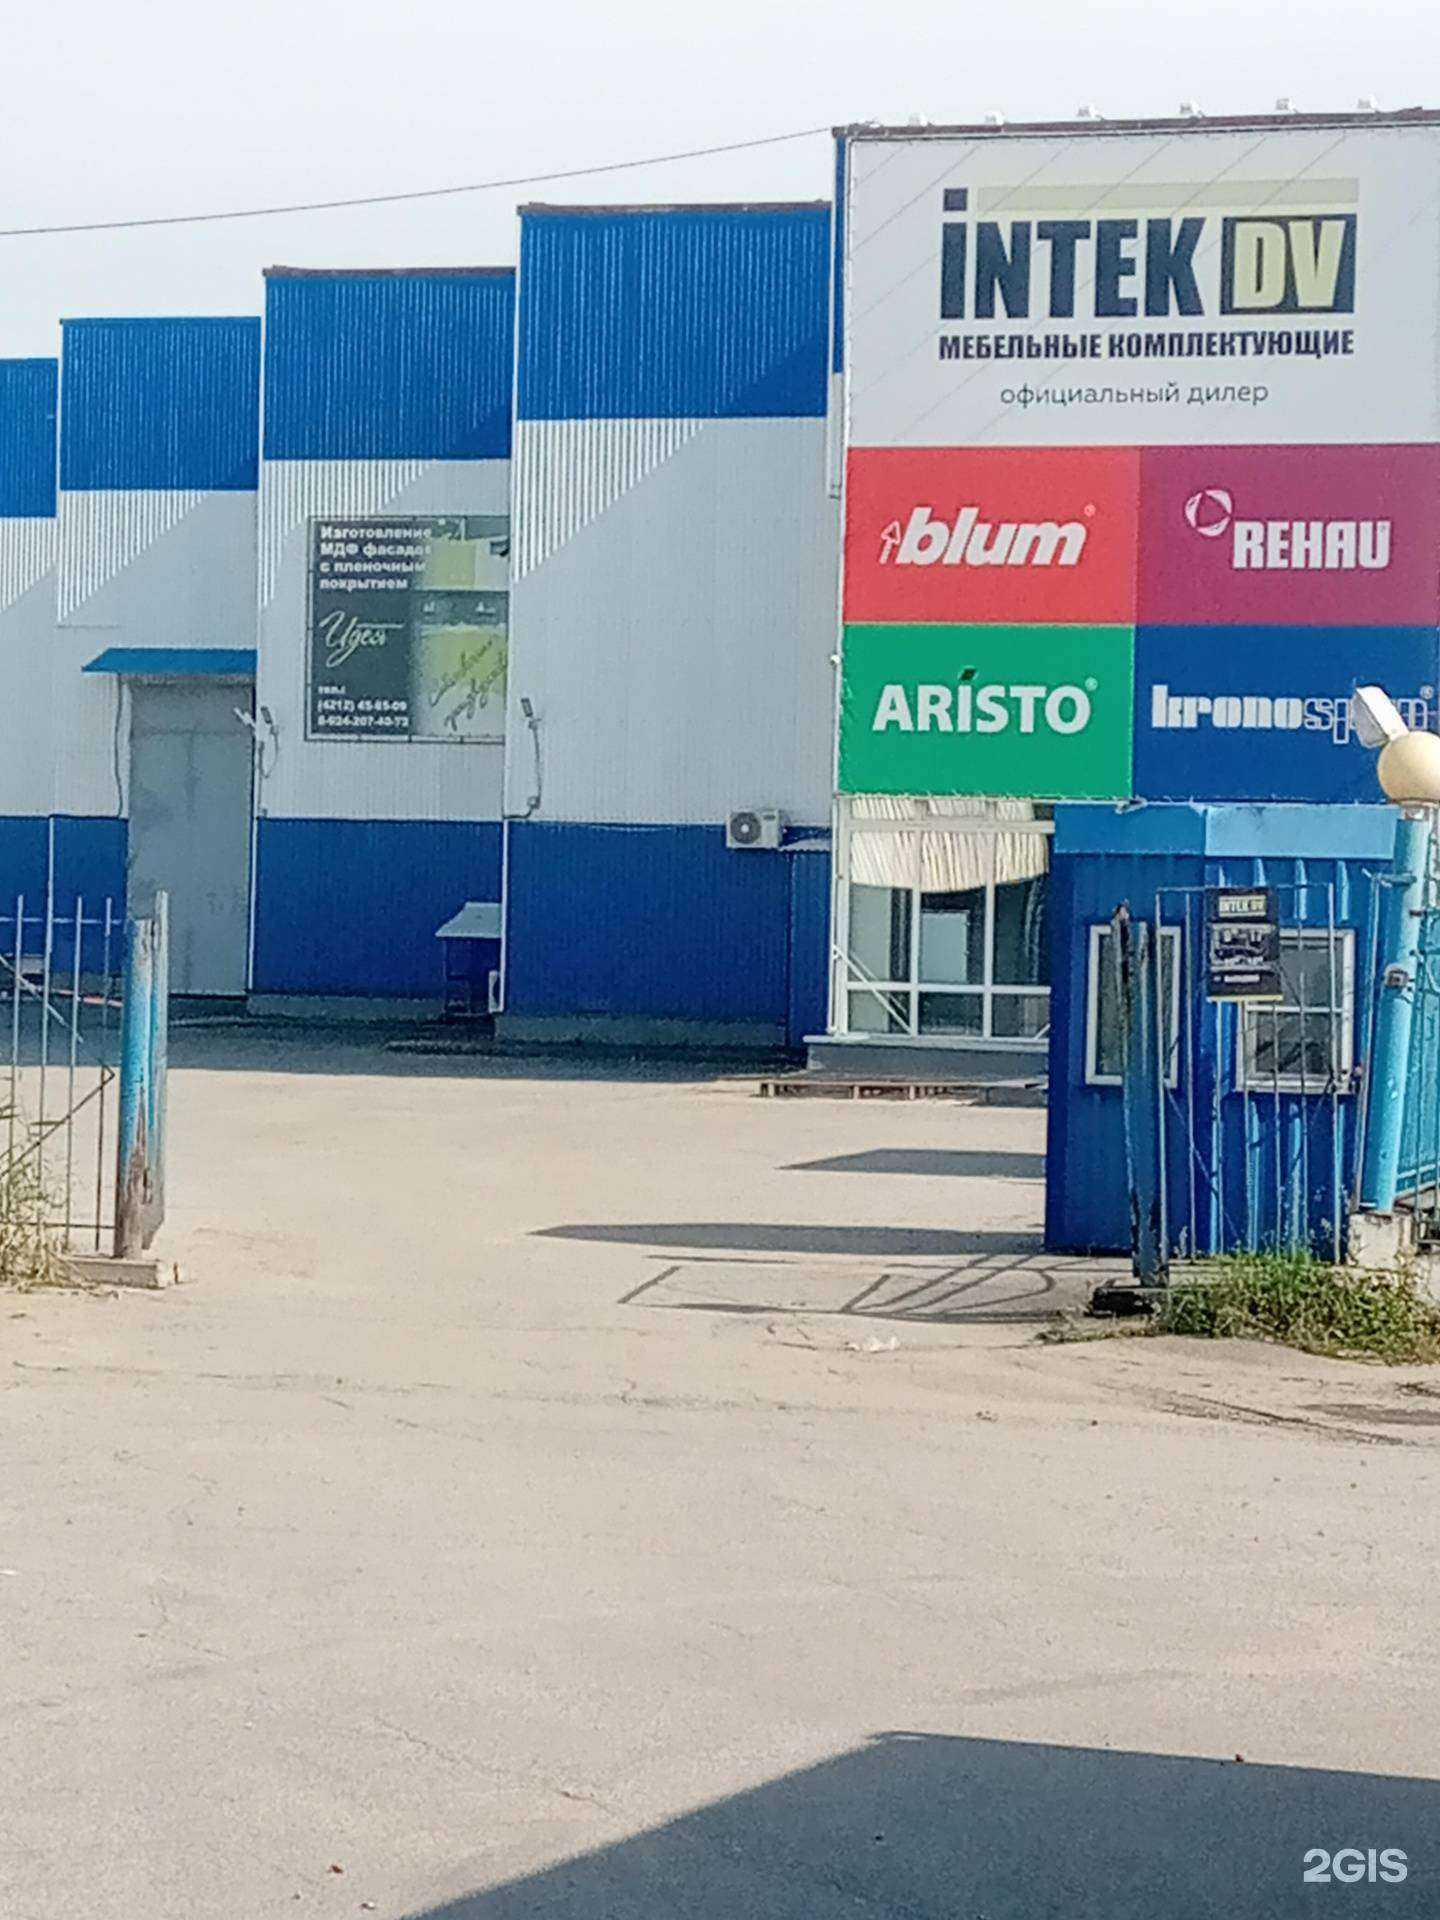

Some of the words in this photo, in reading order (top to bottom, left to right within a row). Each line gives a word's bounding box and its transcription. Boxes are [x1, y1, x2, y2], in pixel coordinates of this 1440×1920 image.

[1231, 219, 1347, 309] DV
[938, 333, 1102, 361] МЕБЕЛЬНЫЕ
[1107, 329, 1355, 359] КОМПЛЕКТУЮЩИЕ
[1000, 382, 1180, 408] официальный
[1186, 383, 1269, 408] дилер
[320, 525, 432, 540] Изготовление
[896, 507, 1087, 566] blum
[1232, 520, 1391, 569] REHAU
[320, 542, 359, 558] МДФ
[319, 562, 330, 572] с
[319, 578, 408, 593] покрытием
